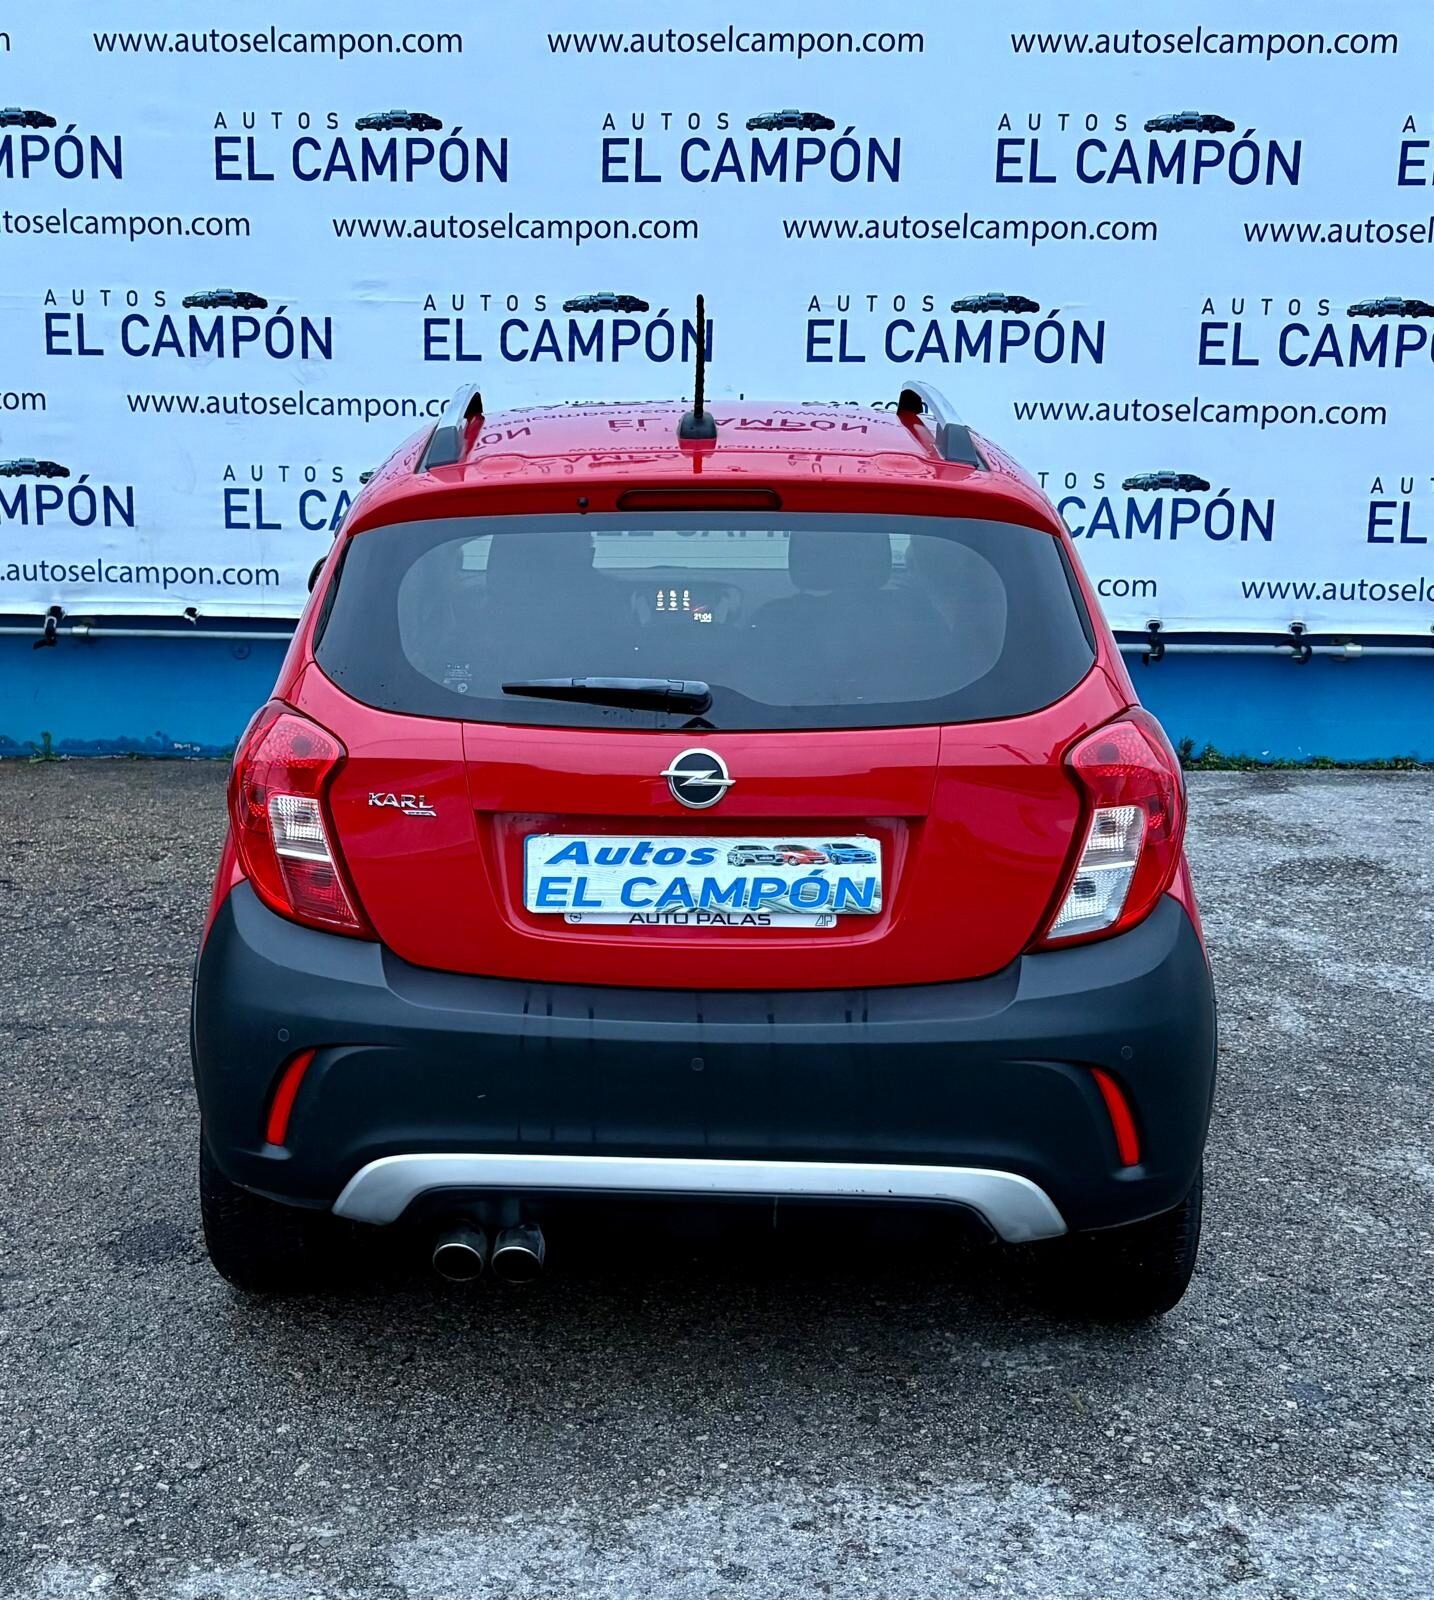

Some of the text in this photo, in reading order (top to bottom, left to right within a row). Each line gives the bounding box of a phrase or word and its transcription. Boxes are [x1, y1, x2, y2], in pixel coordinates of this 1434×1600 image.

[93, 26, 463, 60] www.autoselcampon.com
[547, 25, 924, 60] www.autoselcampon.com
[1010, 26, 1398, 60] www.autoselcampon.com
[213, 112, 339, 130] AUTOS
[602, 113, 729, 130] AUTOS
[997, 114, 1127, 132] AUTOS
[214, 125, 508, 183] EL CAMPÓN
[601, 127, 901, 183] EL CAMPÓN
[995, 128, 1302, 186] EL CAMPÓN
[1397, 140, 1434, 186] E
[0, 208, 250, 242] toselcampon.com
[332, 213, 698, 246] www.autoselcampon.com
[782, 213, 1158, 247] www.autoselcampon.com
[44, 289, 166, 307] AUTOS
[423, 294, 547, 312] AUTOS
[807, 295, 934, 313] AUTOS
[1201, 298, 1330, 316] AUTOS
[44, 305, 333, 360] EL CAMPÓN
[423, 308, 714, 363] EL CAMPÓN
[806, 309, 1105, 365] EL CAMPÓN
[1198, 321, 1434, 368] EL CAMP
[126, 390, 450, 422] www.autoselcampon.c
[1013, 397, 1387, 430] www.autoselcampon.com
[223, 465, 344, 483] AUTOS
[1037, 472, 1105, 490] TOS
[223, 487, 282, 530] EL
[1057, 488, 1275, 541] CAMPÓN
[1366, 500, 1428, 544] EL
[368, 792, 434, 809] KARL
[543, 841, 718, 866] Autos
[535, 869, 876, 909] EL CAMPÓN
[628, 912, 772, 926] AUTO PALAS
